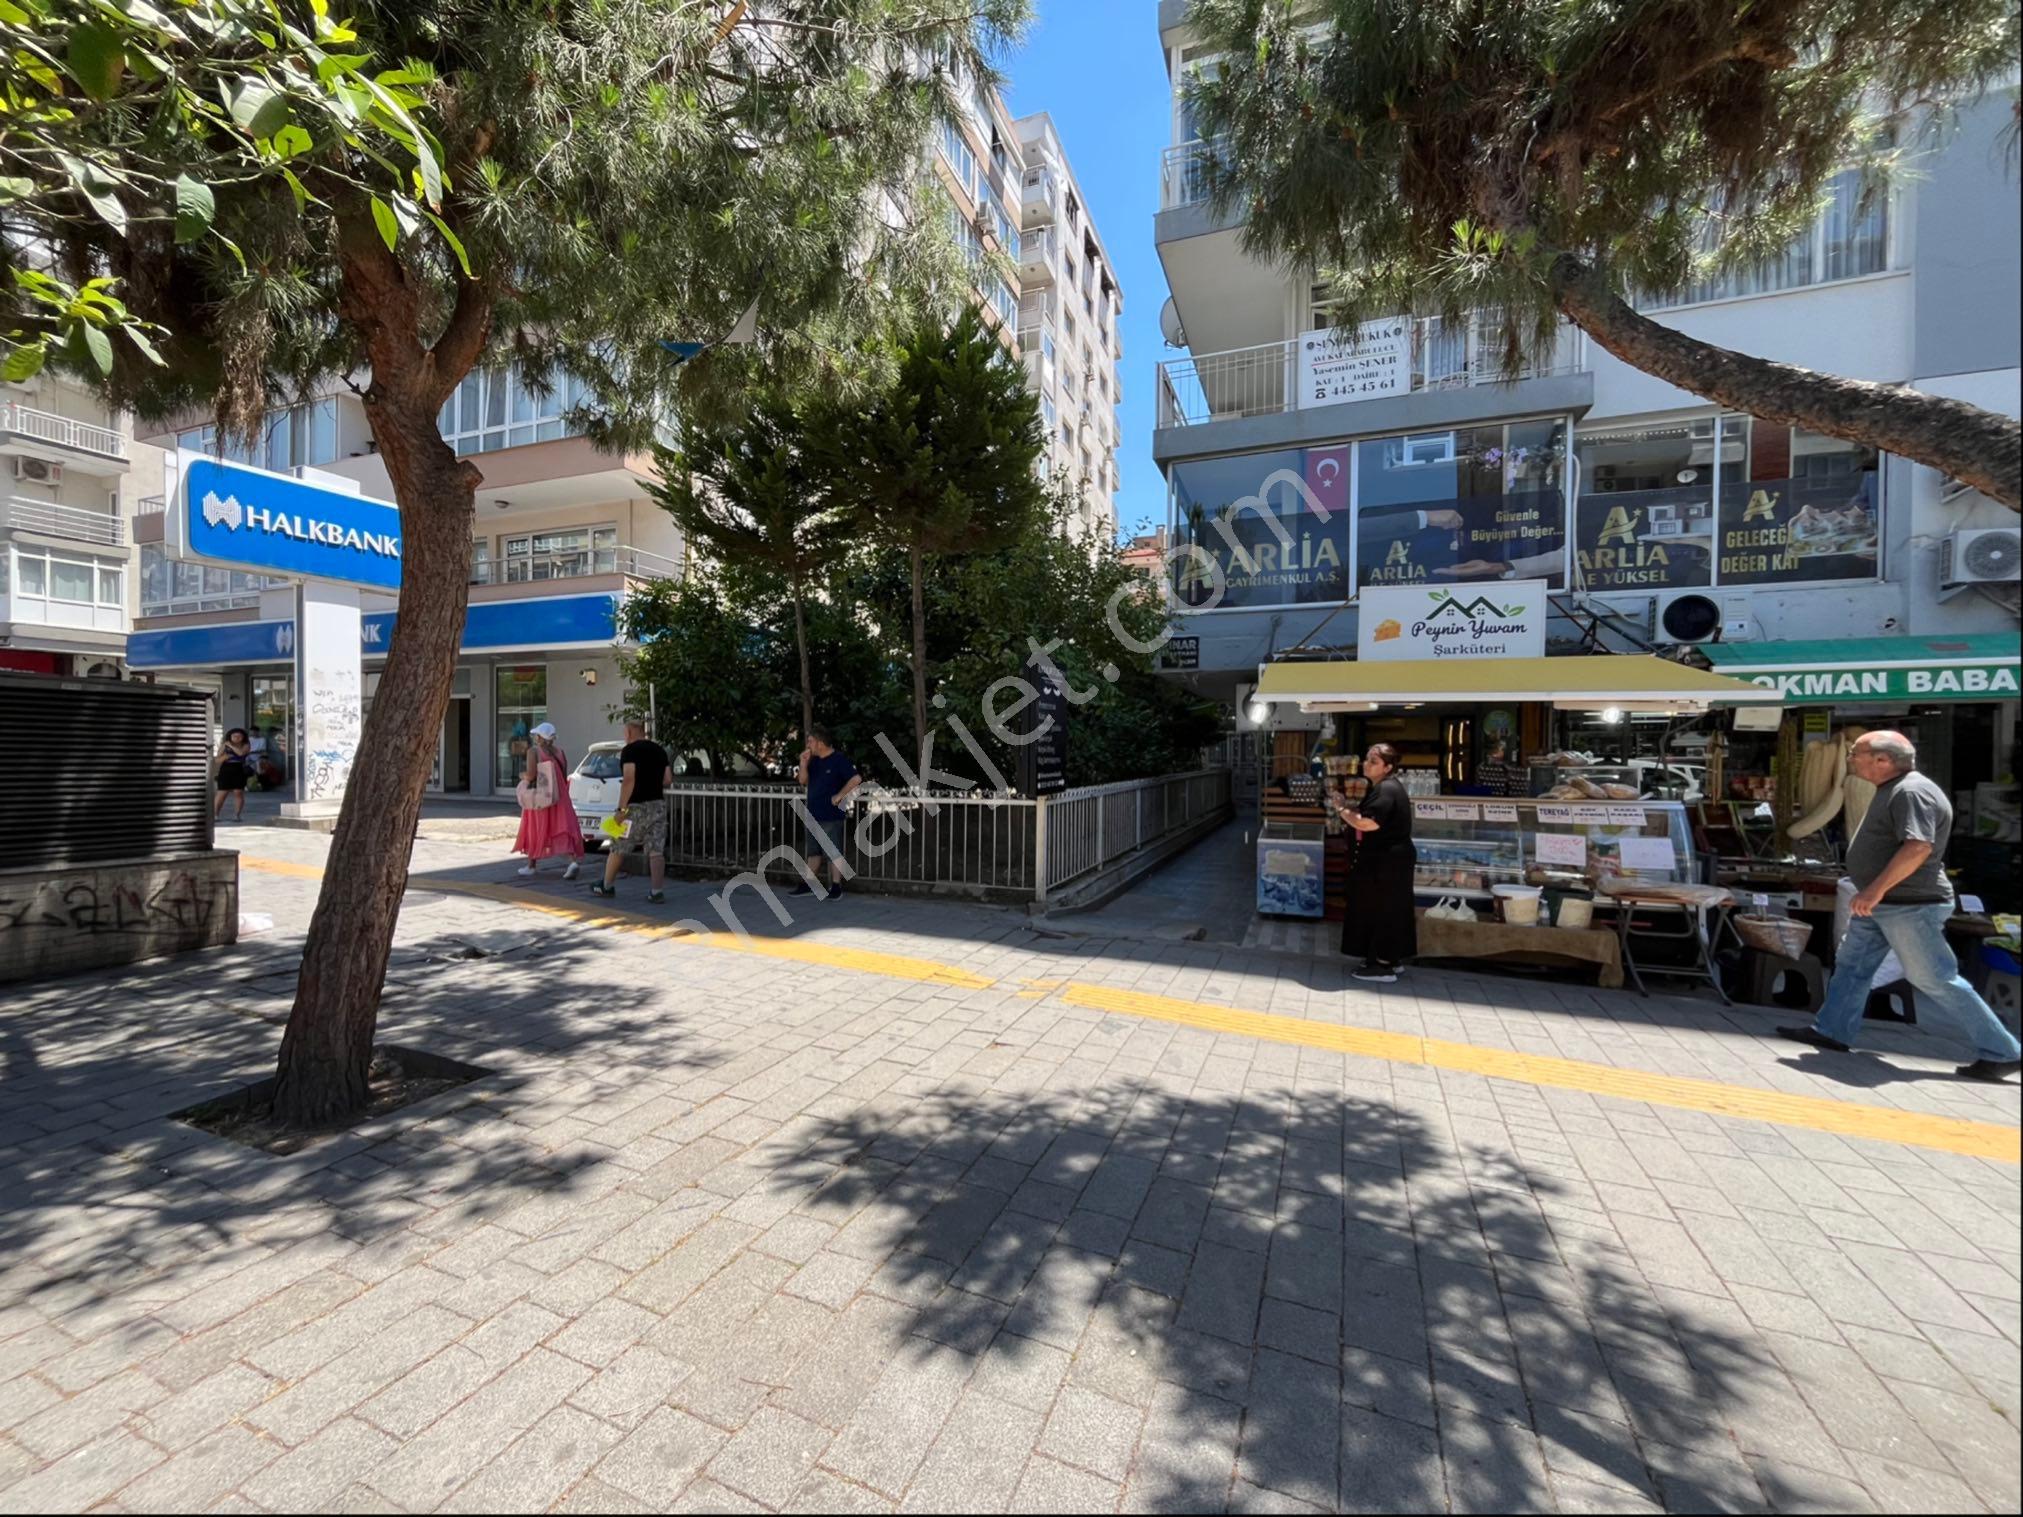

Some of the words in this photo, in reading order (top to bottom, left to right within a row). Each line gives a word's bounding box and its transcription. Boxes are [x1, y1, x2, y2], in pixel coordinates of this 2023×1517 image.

[1313, 363, 1356, 375] Yasemin
[1332, 384, 1356, 395] 445
[1360, 381, 1375, 392] 45
[1380, 379, 1395, 389] 61
[1495, 509, 1540, 523] Güvenle
[247, 505, 399, 556] HALKBANK
[1471, 529, 1517, 543] Büyüyen
[1226, 532, 1341, 574] ARLİA
[1574, 541, 1670, 569] ARLİA
[1370, 562, 1427, 580] ARLİA
[1721, 552, 1767, 573] DEĞER
[1604, 569, 1670, 584] YÜKSEL
[1411, 621, 1466, 642] Peynir
[1468, 620, 1528, 639] Yuvam
[1433, 643, 1506, 657] Şarküteri
[1750, 672, 1888, 695] OKMAN
[1907, 669, 2018, 693] BABA
